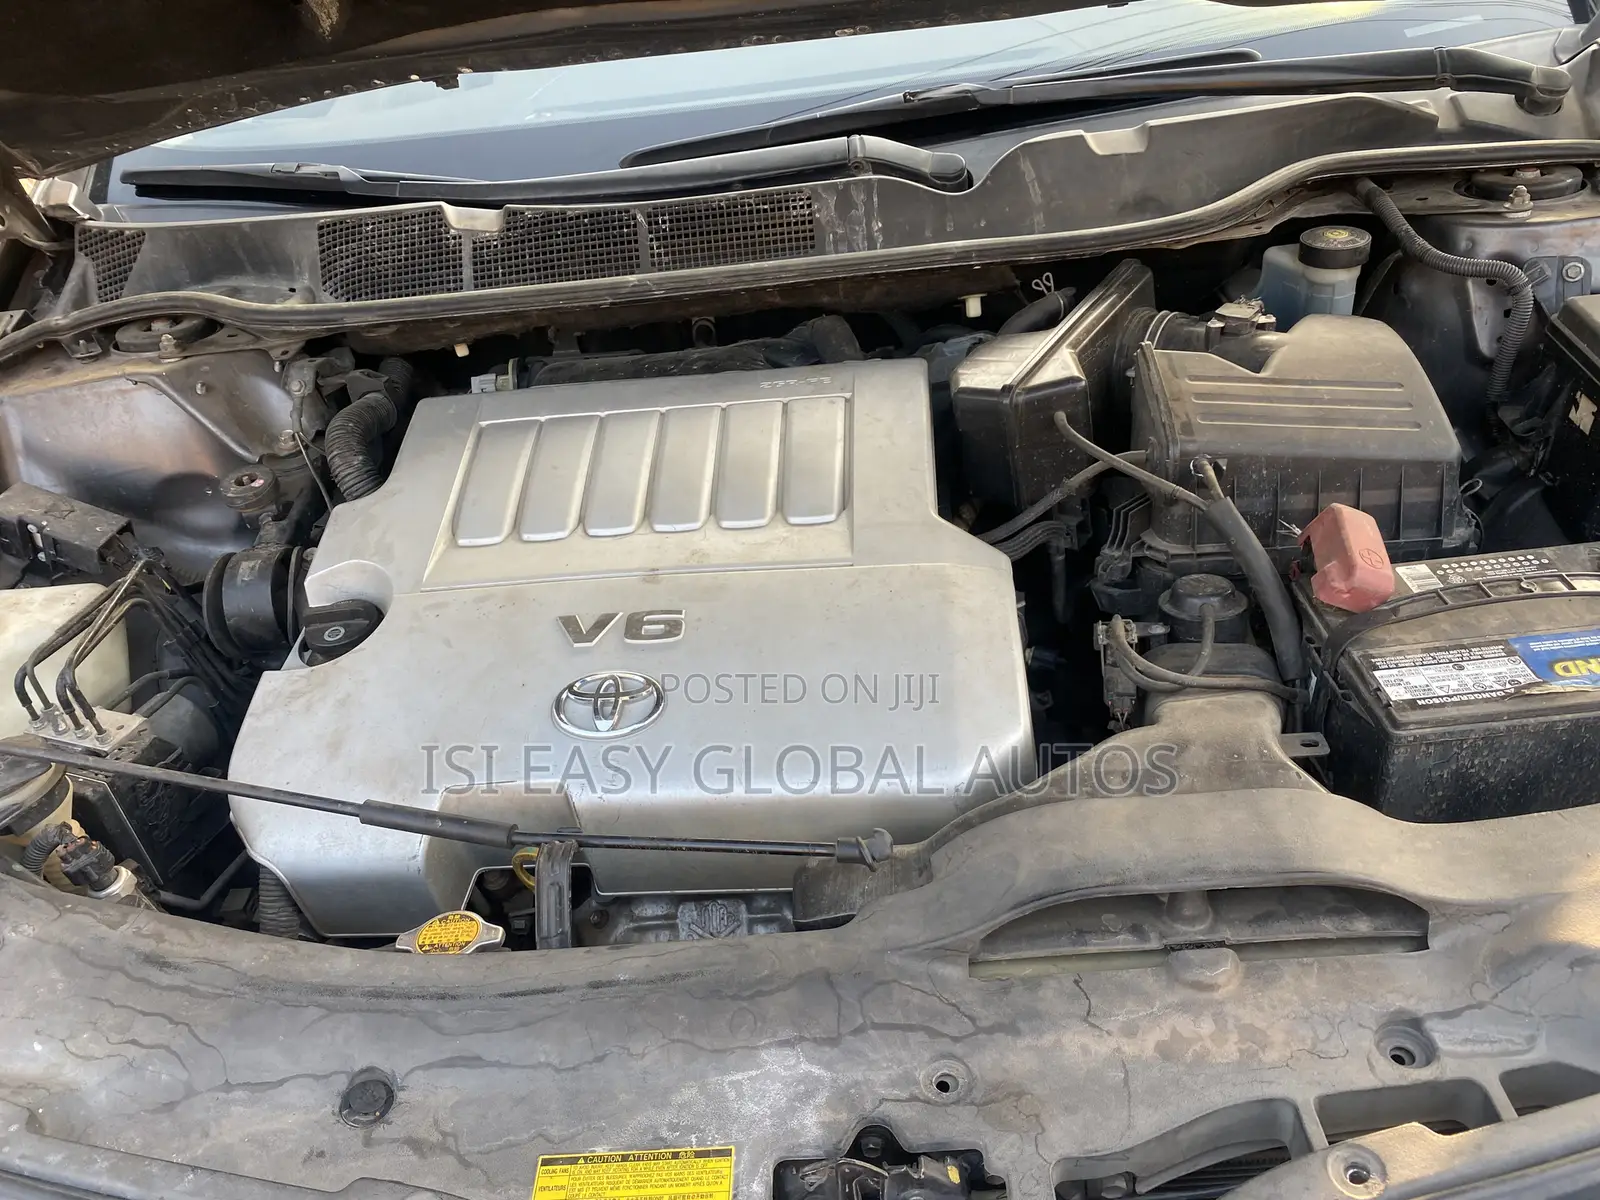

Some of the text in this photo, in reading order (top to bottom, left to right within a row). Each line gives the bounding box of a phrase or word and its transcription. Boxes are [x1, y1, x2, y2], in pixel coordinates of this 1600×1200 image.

[556, 609, 686, 647] V6
[1554, 658, 1600, 677] ND
[1416, 689, 1506, 705] DANGER/POISON
[587, 1152, 672, 1164] CAUTION ATTENTION
